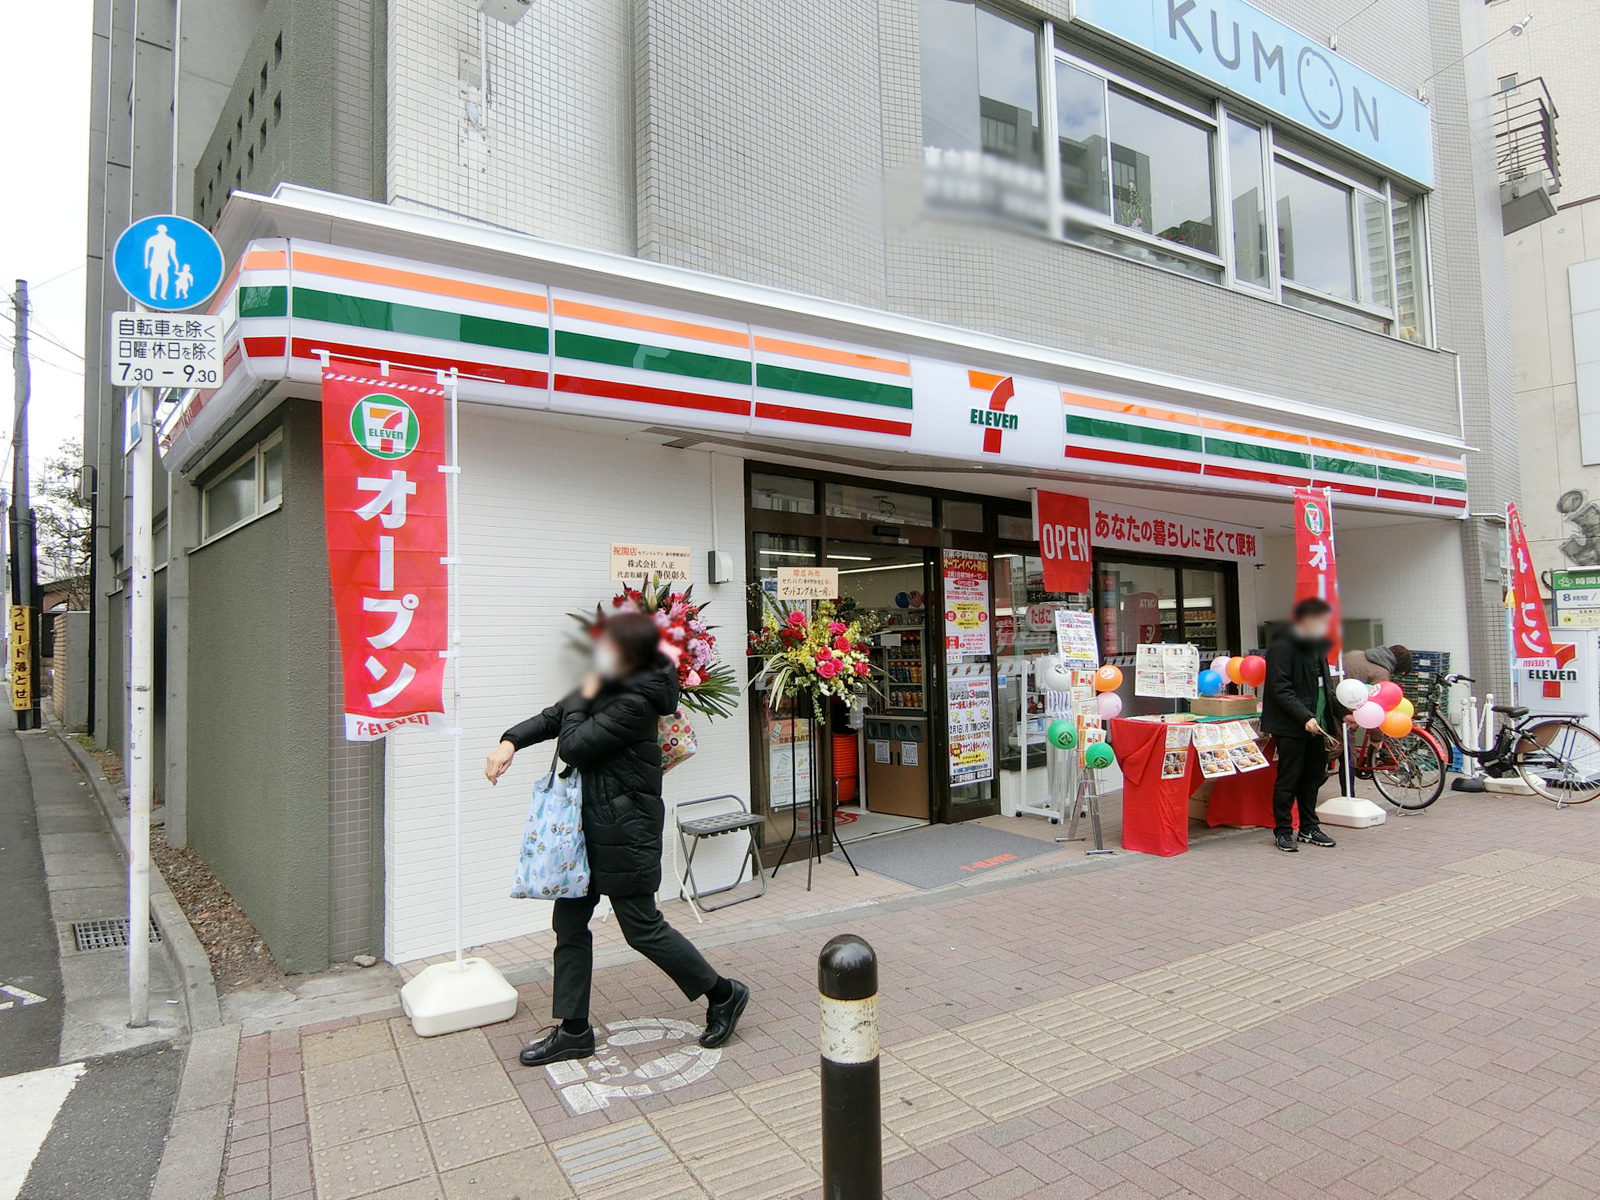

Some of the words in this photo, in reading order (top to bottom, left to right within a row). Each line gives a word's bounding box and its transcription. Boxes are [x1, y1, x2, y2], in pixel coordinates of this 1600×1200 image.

[1168, 0, 1380, 142] KUMON
[119, 318, 216, 338] 自転車を除く
[1042, 523, 1090, 563] OPEN
[628, 559, 657, 569] 株式会社
[354, 469, 420, 708] オープン
[1031, 608, 1053, 625] たばこ
[14, 607, 28, 699] スピード落とせ
